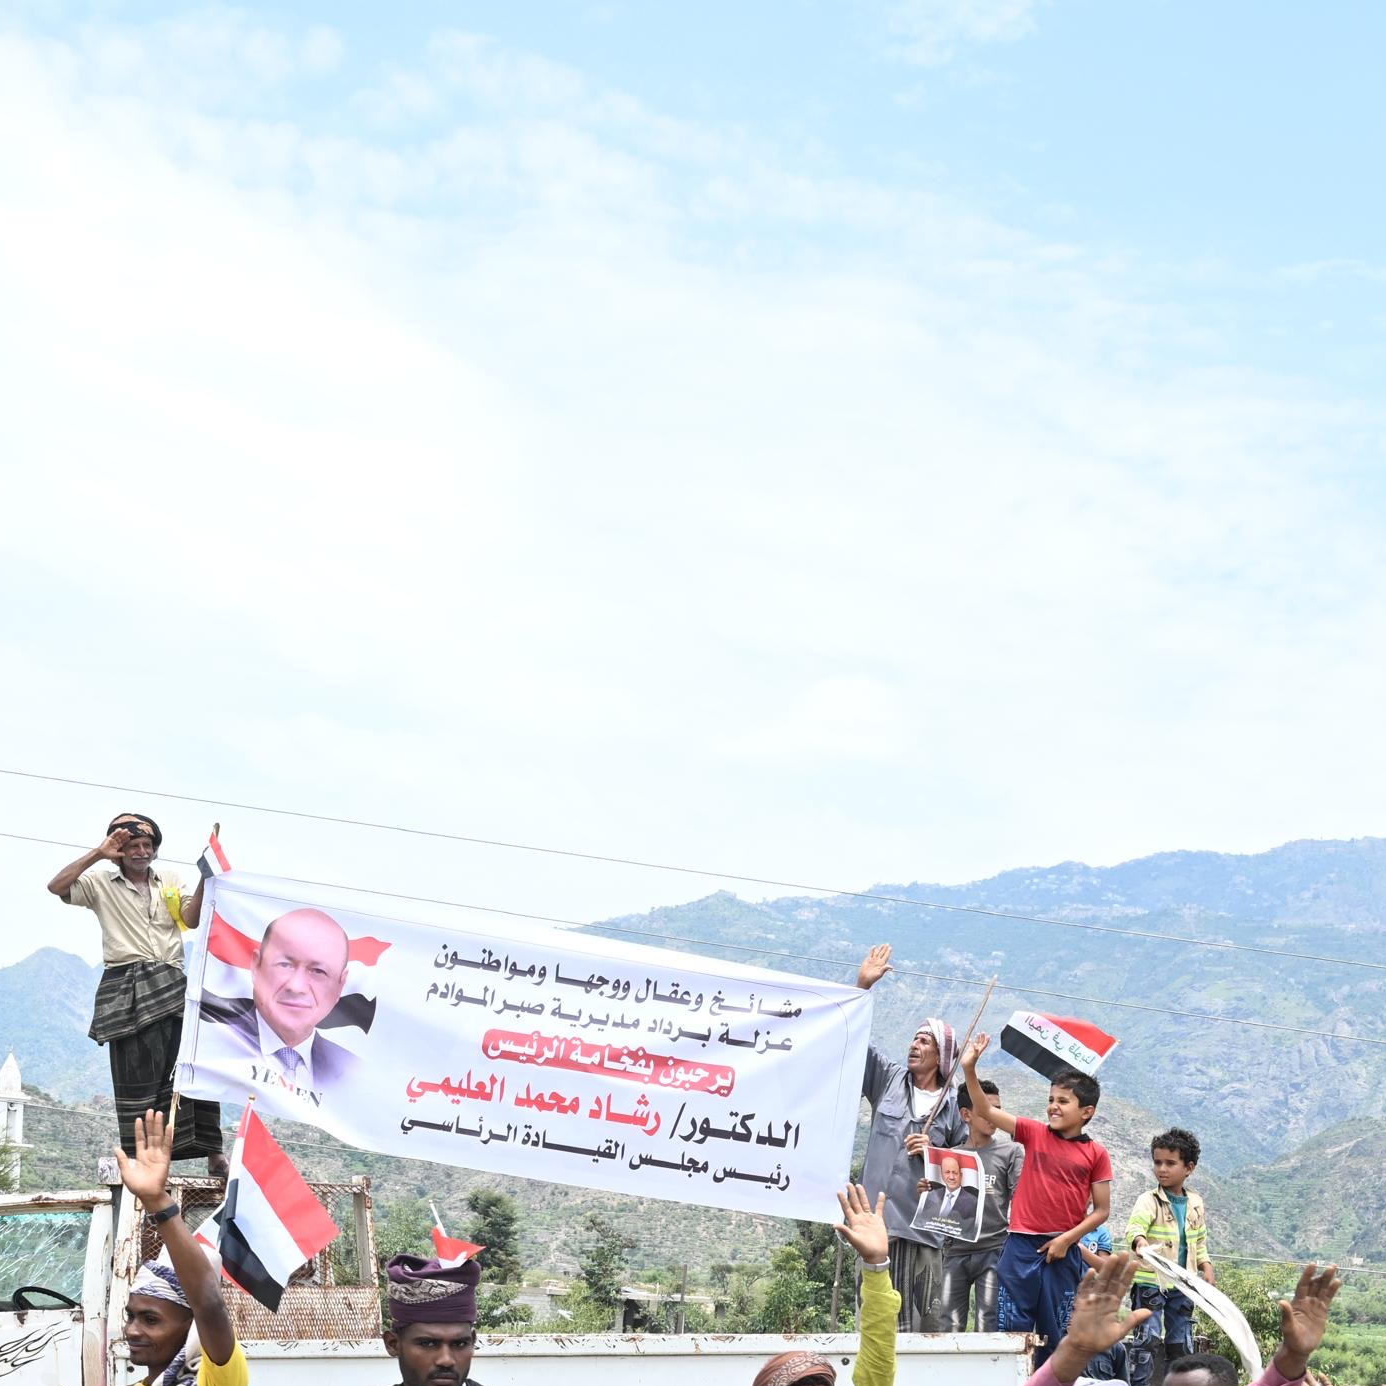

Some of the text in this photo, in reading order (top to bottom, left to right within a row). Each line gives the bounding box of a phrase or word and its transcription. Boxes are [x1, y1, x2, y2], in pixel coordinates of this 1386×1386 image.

[433, 943, 802, 1018] مشائخ وعقال ووجها ومواطنون
[426, 981, 793, 1054] عزلة برداد مديرية صبر الموادم
[406, 1069, 505, 1104] العليمي
[486, 1033, 732, 1094] يرحبون بفخامة الرئيس
[514, 1082, 580, 1115] محمد
[589, 1093, 661, 1135] رشاد
[400, 1114, 791, 1191] رئيس مجلس القيادة الرئاسي
